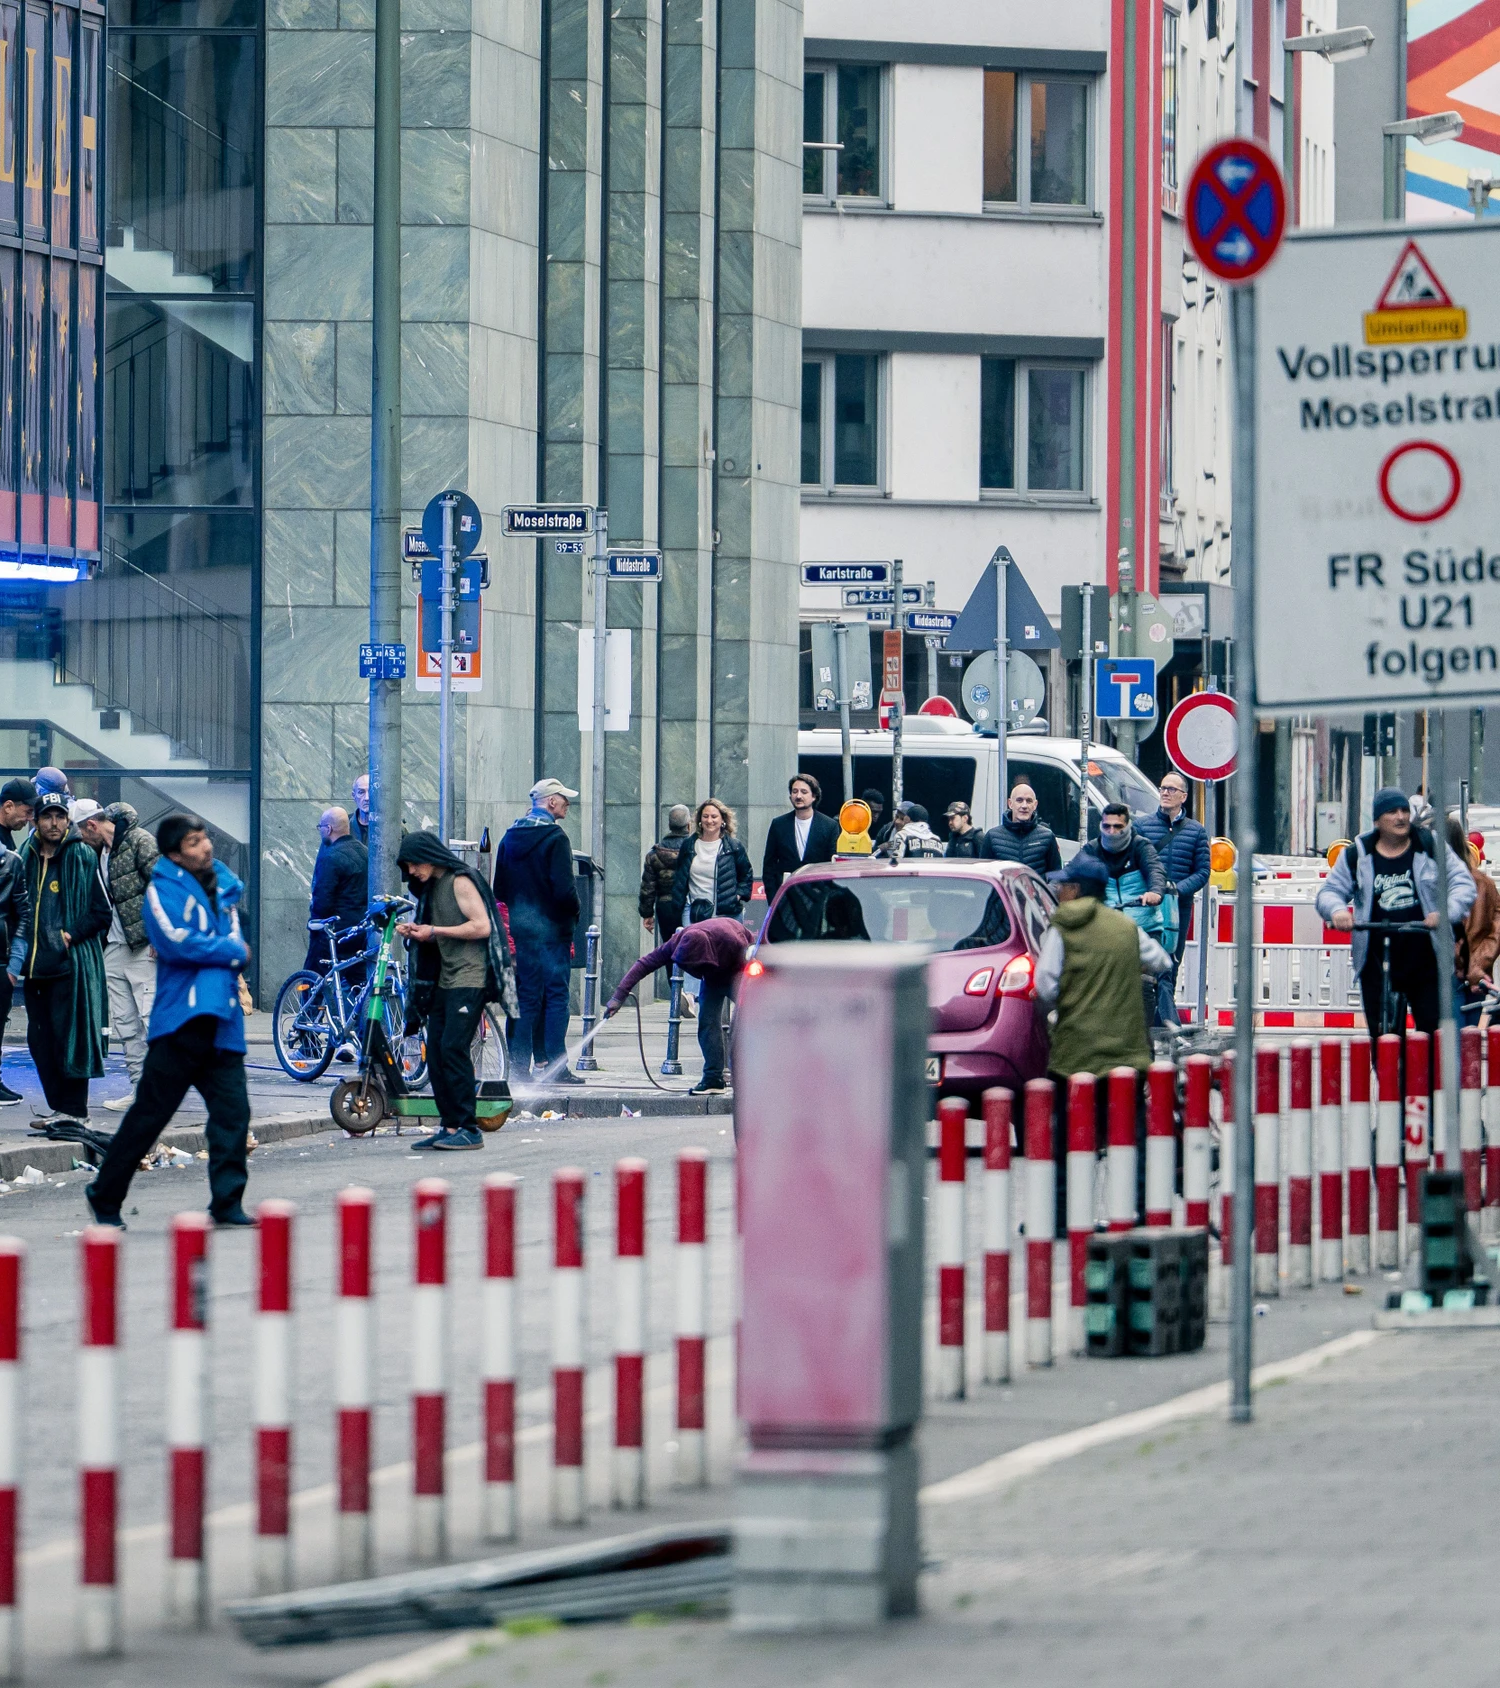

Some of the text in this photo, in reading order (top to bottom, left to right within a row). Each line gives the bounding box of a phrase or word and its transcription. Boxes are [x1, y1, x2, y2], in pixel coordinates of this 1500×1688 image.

[514, 512, 583, 530] Moselstraße
[556, 542, 584, 553] 39-53
[615, 557, 651, 573] Niddastraße
[1328, 552, 1385, 590] FR
[819, 567, 873, 580] Karlstraße
[869, 591, 884, 600] 2-6
[871, 612, 887, 620] 1-11
[1401, 593, 1473, 629] U21
[914, 613, 952, 629] Niddastraße
[1366, 640, 1497, 684] folgen
[42, 792, 61, 805] FBI
